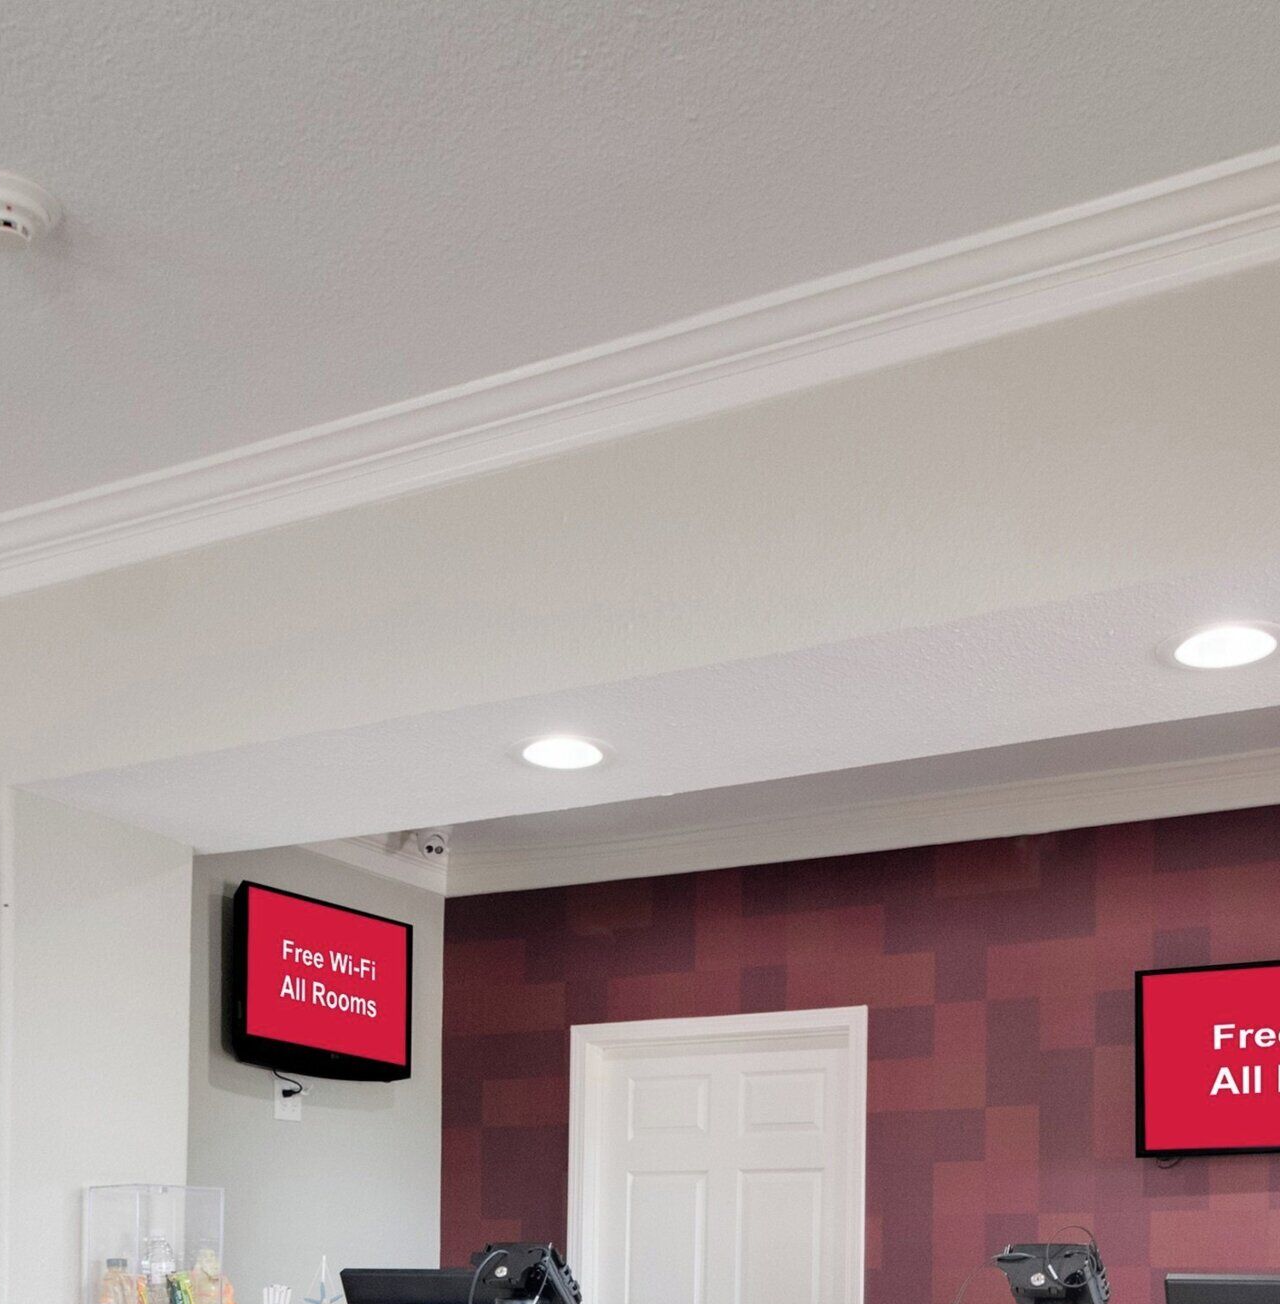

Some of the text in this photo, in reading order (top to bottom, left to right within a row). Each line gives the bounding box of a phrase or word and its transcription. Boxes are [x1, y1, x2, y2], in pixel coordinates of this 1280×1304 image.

[282, 939, 376, 981] Free Wi-Fi
[279, 974, 377, 1018] All Rooms
[1209, 1065, 1262, 1096] All
